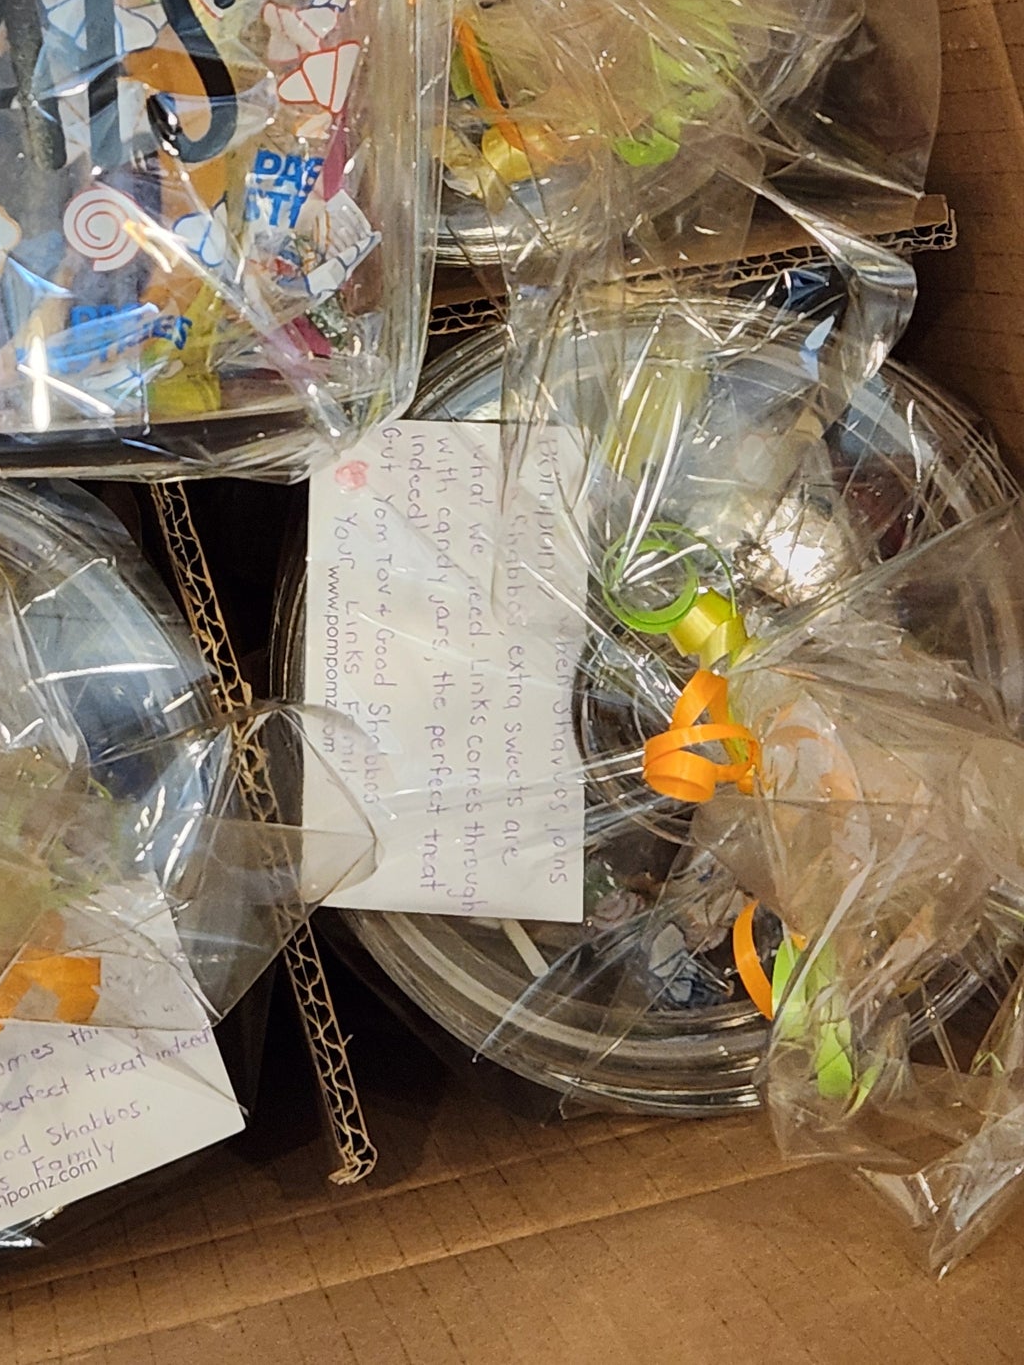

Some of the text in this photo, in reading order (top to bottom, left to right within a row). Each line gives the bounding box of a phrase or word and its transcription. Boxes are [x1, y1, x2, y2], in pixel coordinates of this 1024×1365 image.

[434, 436, 458, 494] with
[371, 493, 395, 544] Yom
[426, 506, 456, 584] candy
[321, 564, 340, 753] www.pompomzom
[343, 600, 364, 674] Links
[372, 627, 397, 687] Good
[431, 670, 456, 710] the
[502, 645, 531, 709] extra
[325, 701, 359, 789] Famil
[423, 724, 453, 815] perfect
[464, 734, 484, 814] comes
[502, 720, 533, 808] sweets
[419, 827, 446, 892] treat
[445, 819, 489, 914] through
[500, 819, 521, 866] are
[80, 1044, 147, 1086] treat
[29, 1131, 120, 1186] Family
